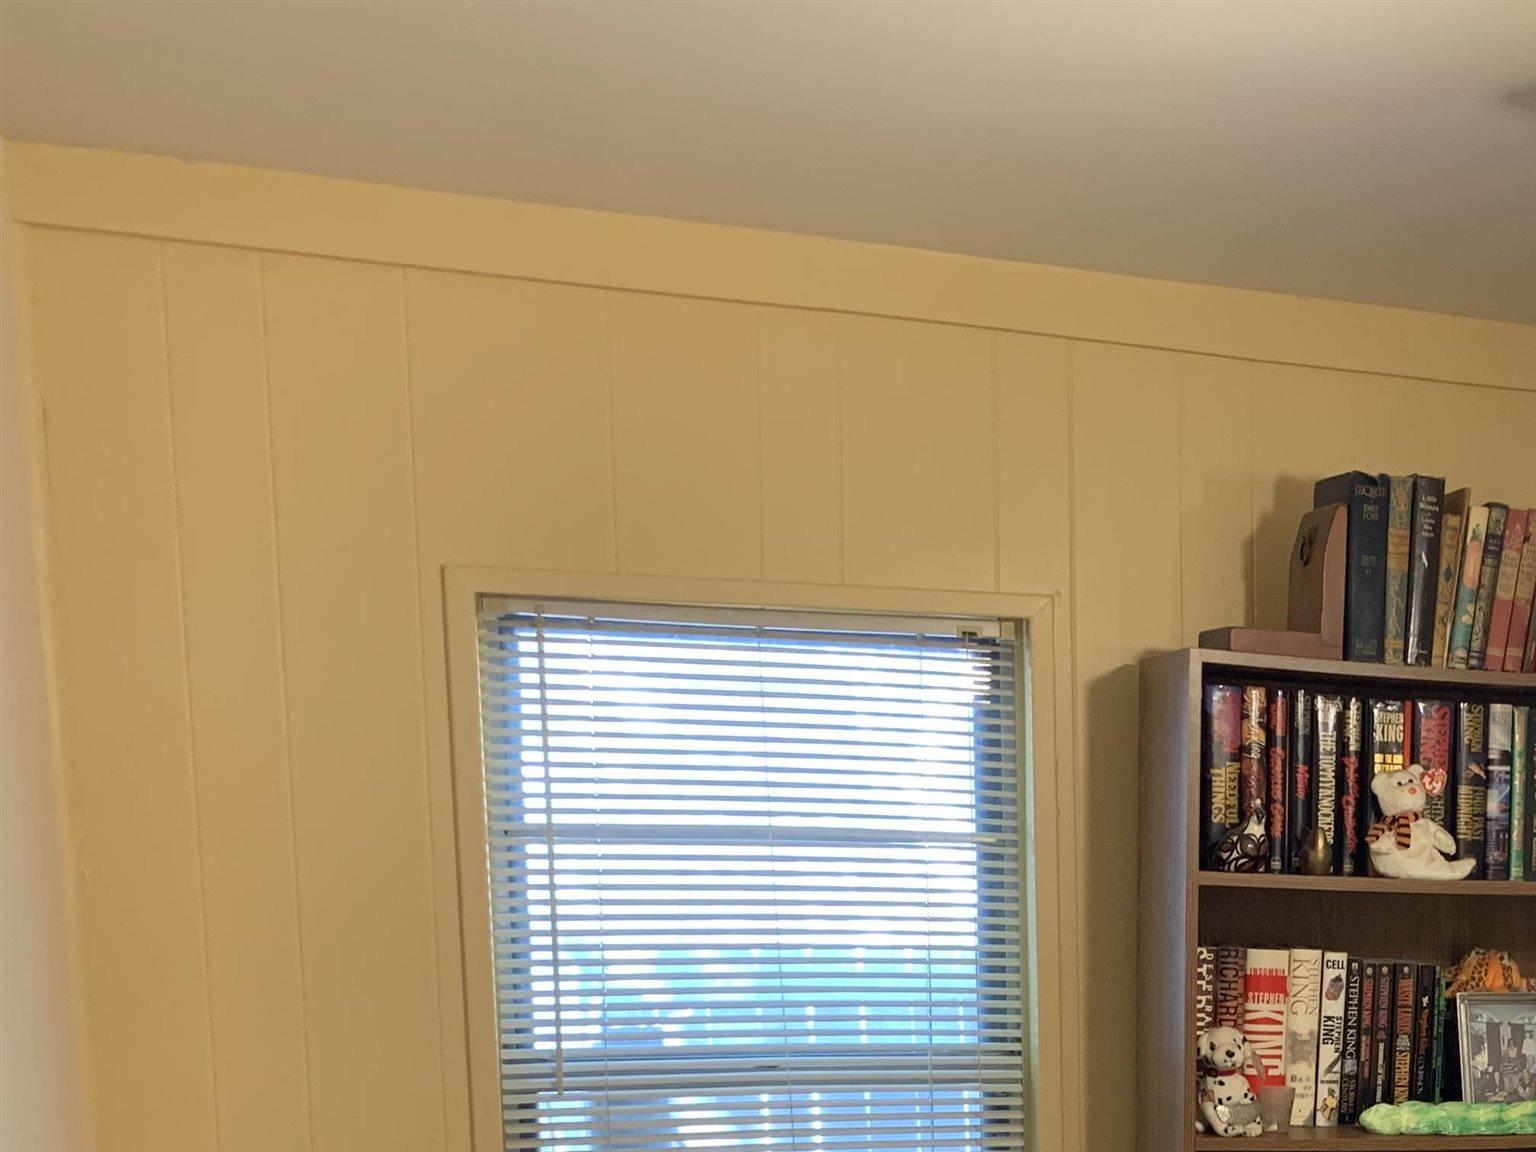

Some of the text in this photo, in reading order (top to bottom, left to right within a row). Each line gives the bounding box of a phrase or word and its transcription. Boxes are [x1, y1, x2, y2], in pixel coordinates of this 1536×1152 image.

[1318, 731, 1336, 753] THE
[1375, 724, 1404, 743] KING
[1470, 704, 1485, 753] STEPHEN
[1210, 766, 1226, 824] THINGS
[1224, 761, 1241, 827] NEEDFUL
[1456, 785, 1475, 840] MIDNIGHT
[1219, 947, 1240, 1028] RICHARD
[1290, 957, 1312, 1016] KING
[1307, 958, 1319, 1016] STEPHEN
[1325, 959, 1345, 970] CELL
[1203, 953, 1215, 1032] DESPERA
[1248, 991, 1286, 1006] STEPHEN
[1345, 975, 1360, 1060] STEPHEN KING
[1243, 1009, 1286, 1077] KING
[1322, 1015, 1336, 1045] KING
[1334, 1015, 1343, 1053] STEPHEN
[1394, 1051, 1411, 1085] STEPHEN
